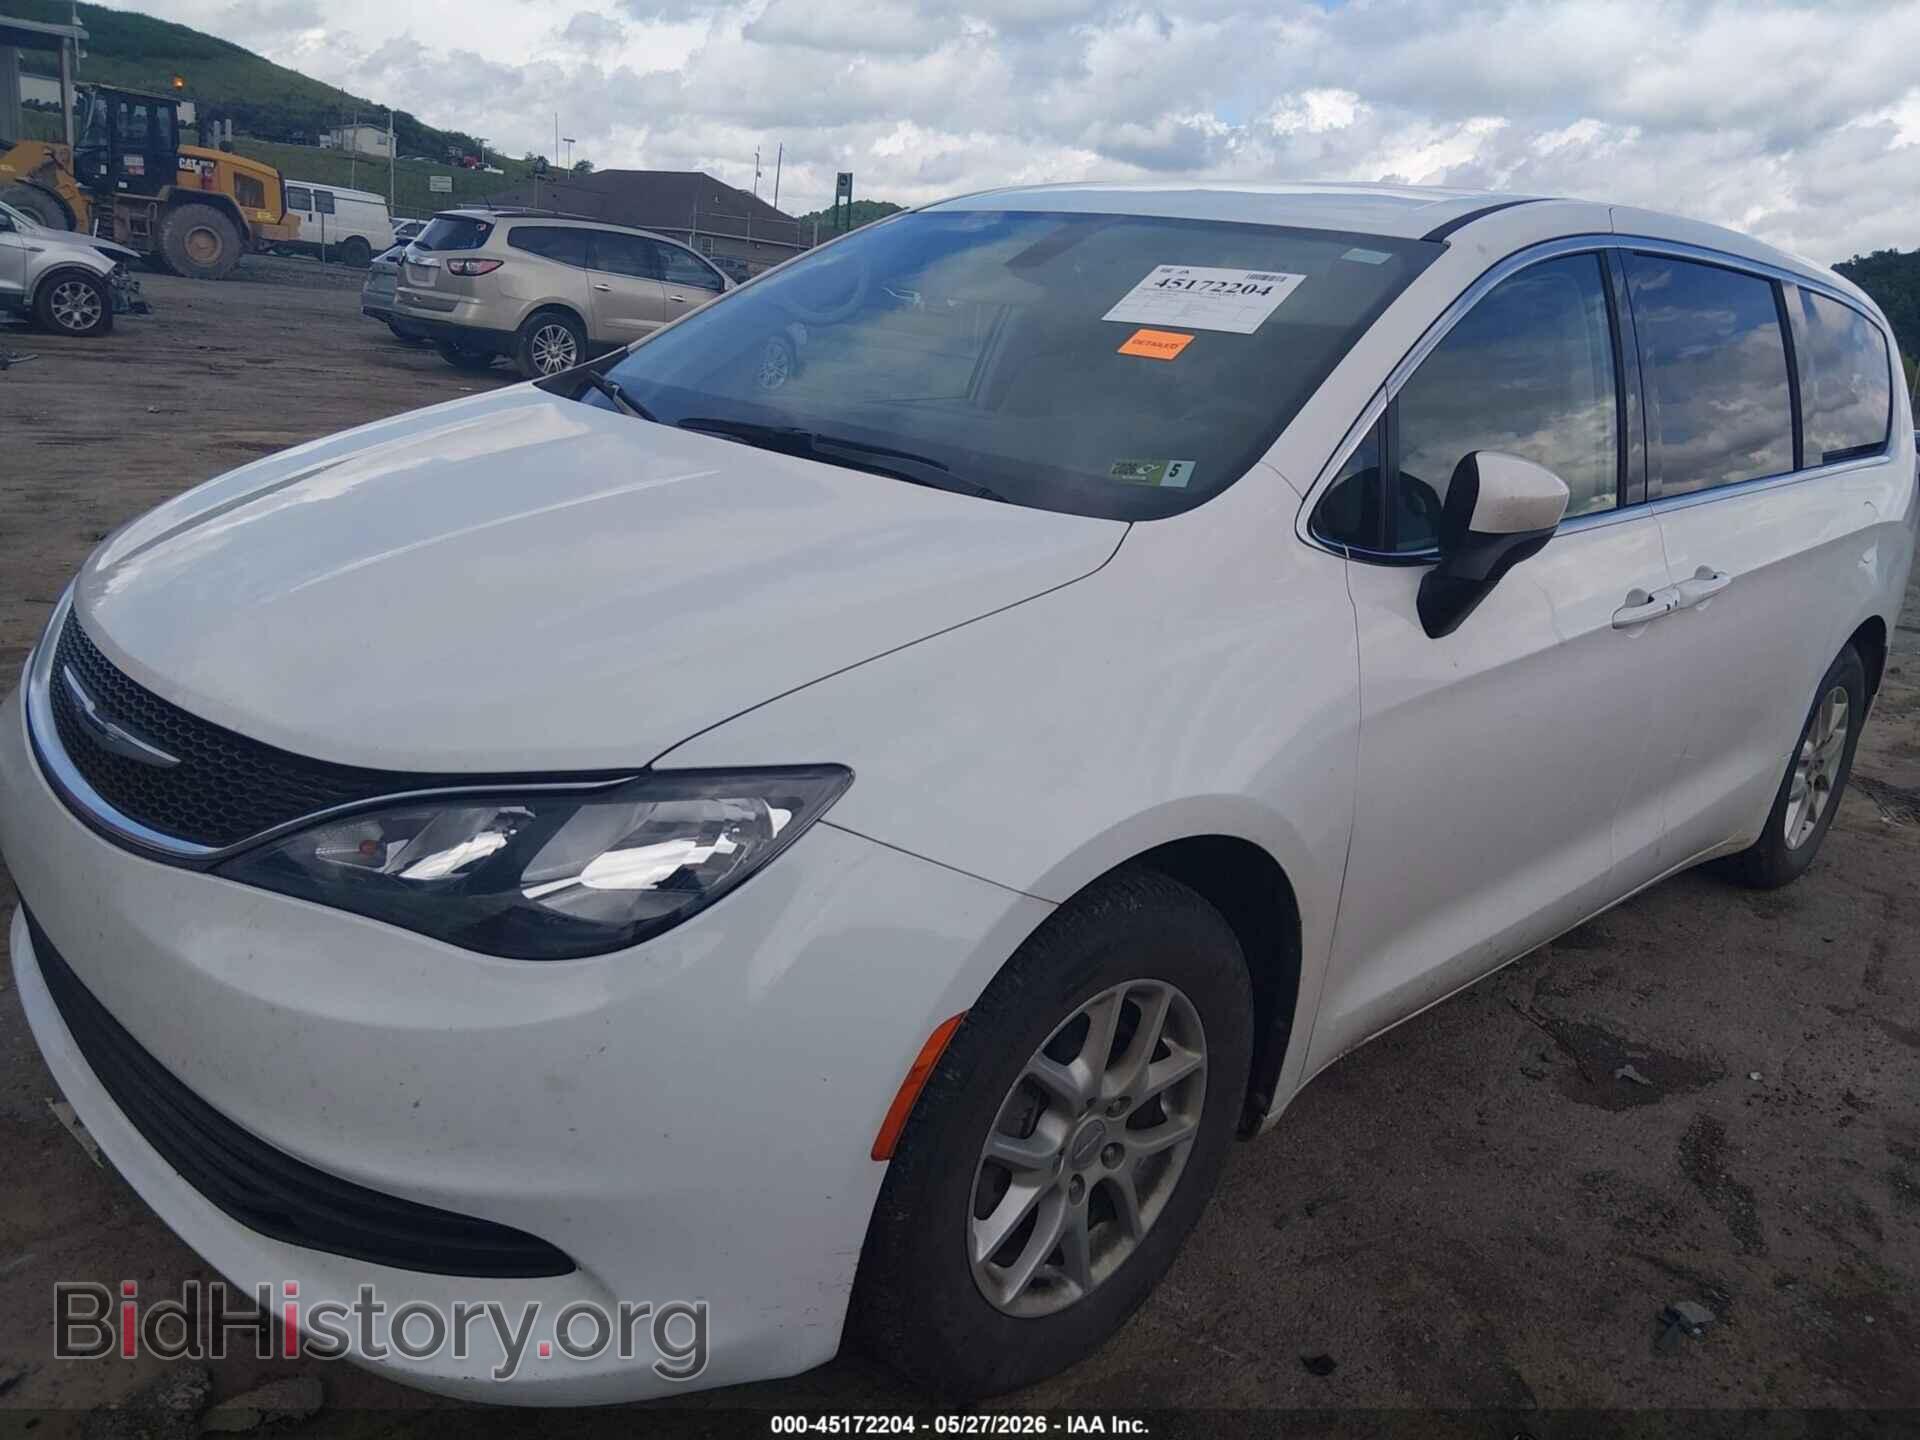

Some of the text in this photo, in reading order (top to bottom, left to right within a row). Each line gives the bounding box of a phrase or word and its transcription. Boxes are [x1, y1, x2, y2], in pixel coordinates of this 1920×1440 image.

[178, 157, 198, 170] CAT
[1154, 277, 1274, 297] 45172204
[1168, 463, 1182, 478] 5
